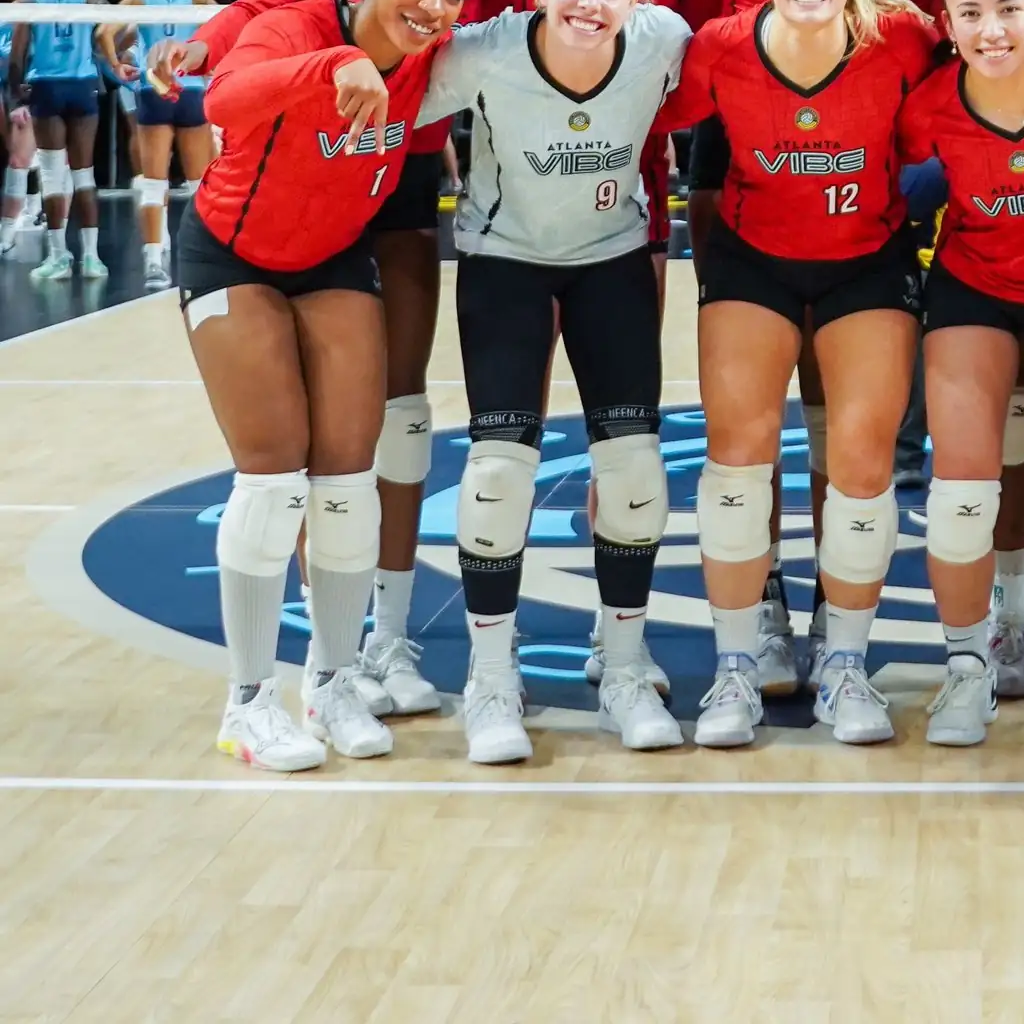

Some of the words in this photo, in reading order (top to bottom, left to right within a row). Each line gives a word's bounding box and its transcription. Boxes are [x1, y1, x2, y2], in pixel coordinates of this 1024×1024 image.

[318, 120, 406, 159] VBE
[547, 140, 612, 152] ATLANTA
[773, 140, 842, 151] ATLANTA
[523, 144, 633, 176] VIBE
[753, 147, 866, 174] VIBE
[369, 164, 389, 197] 1
[596, 179, 618, 211] 9
[823, 182, 860, 215] 12
